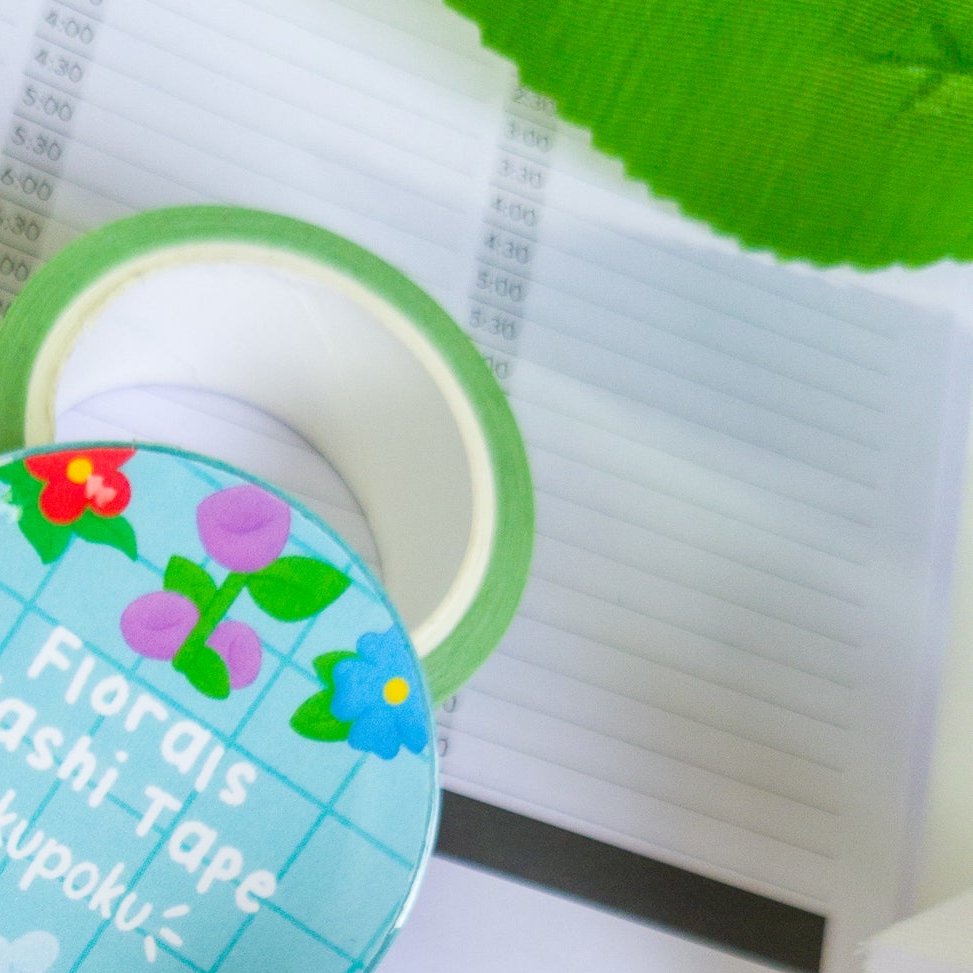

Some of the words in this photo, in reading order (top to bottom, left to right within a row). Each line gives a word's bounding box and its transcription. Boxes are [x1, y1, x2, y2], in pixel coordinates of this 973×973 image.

[44, 9, 94, 44] 4:00
[34, 48, 84, 83] 4:30
[22, 86, 73, 122] 5:00
[11, 125, 63, 162] 5:30
[0, 168, 53, 201] 6:00
[27, 625, 257, 806] Florals
[136, 785, 277, 914] Tape
